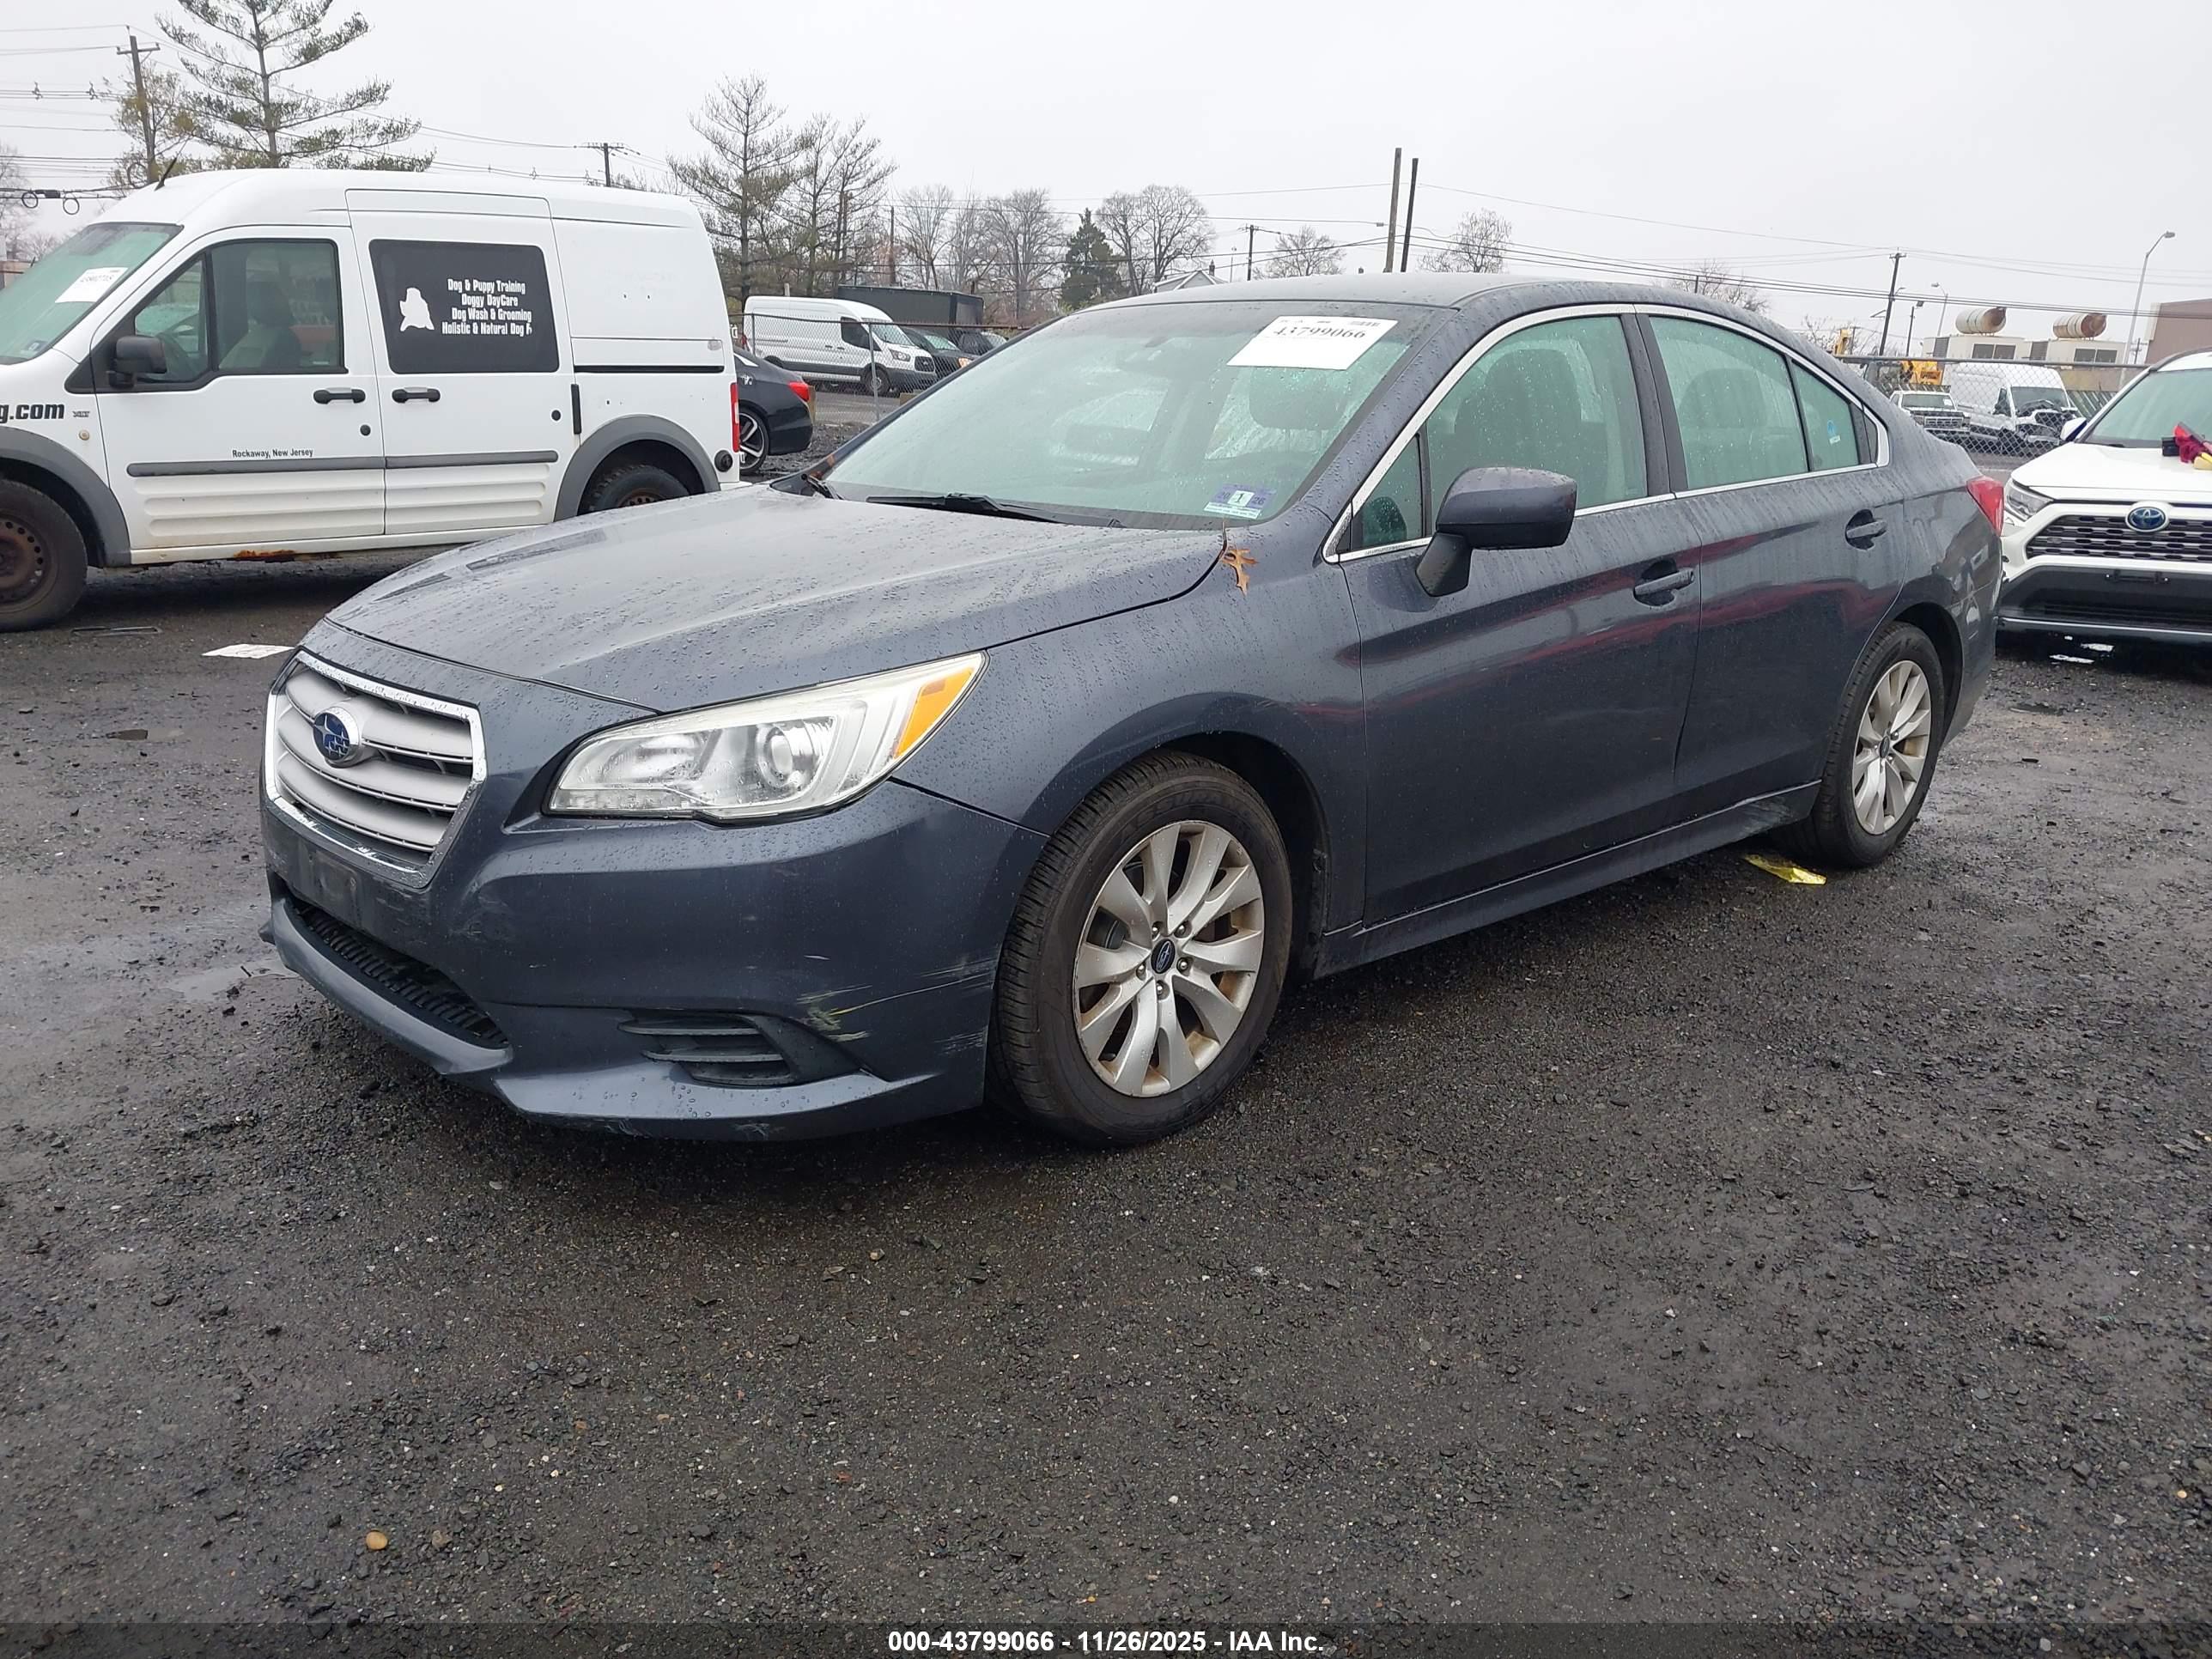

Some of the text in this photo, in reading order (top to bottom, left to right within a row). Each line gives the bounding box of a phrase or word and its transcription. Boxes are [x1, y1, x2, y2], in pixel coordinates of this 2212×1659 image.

[447, 279, 526, 295] Dog & Puppy Training
[461, 294, 519, 307] Doggy DayCare
[452, 307, 532, 322] Dog Wash & Grooming
[441, 321, 471, 334] Holistic
[472, 322, 478, 334] &
[480, 322, 508, 334] Natural
[510, 323, 525, 337] Dog
[1273, 326, 1366, 339] 43799066
[232, 449, 270, 459] Rockaway,
[290, 448, 313, 457] Jersey
[1234, 493, 1244, 503] 1
